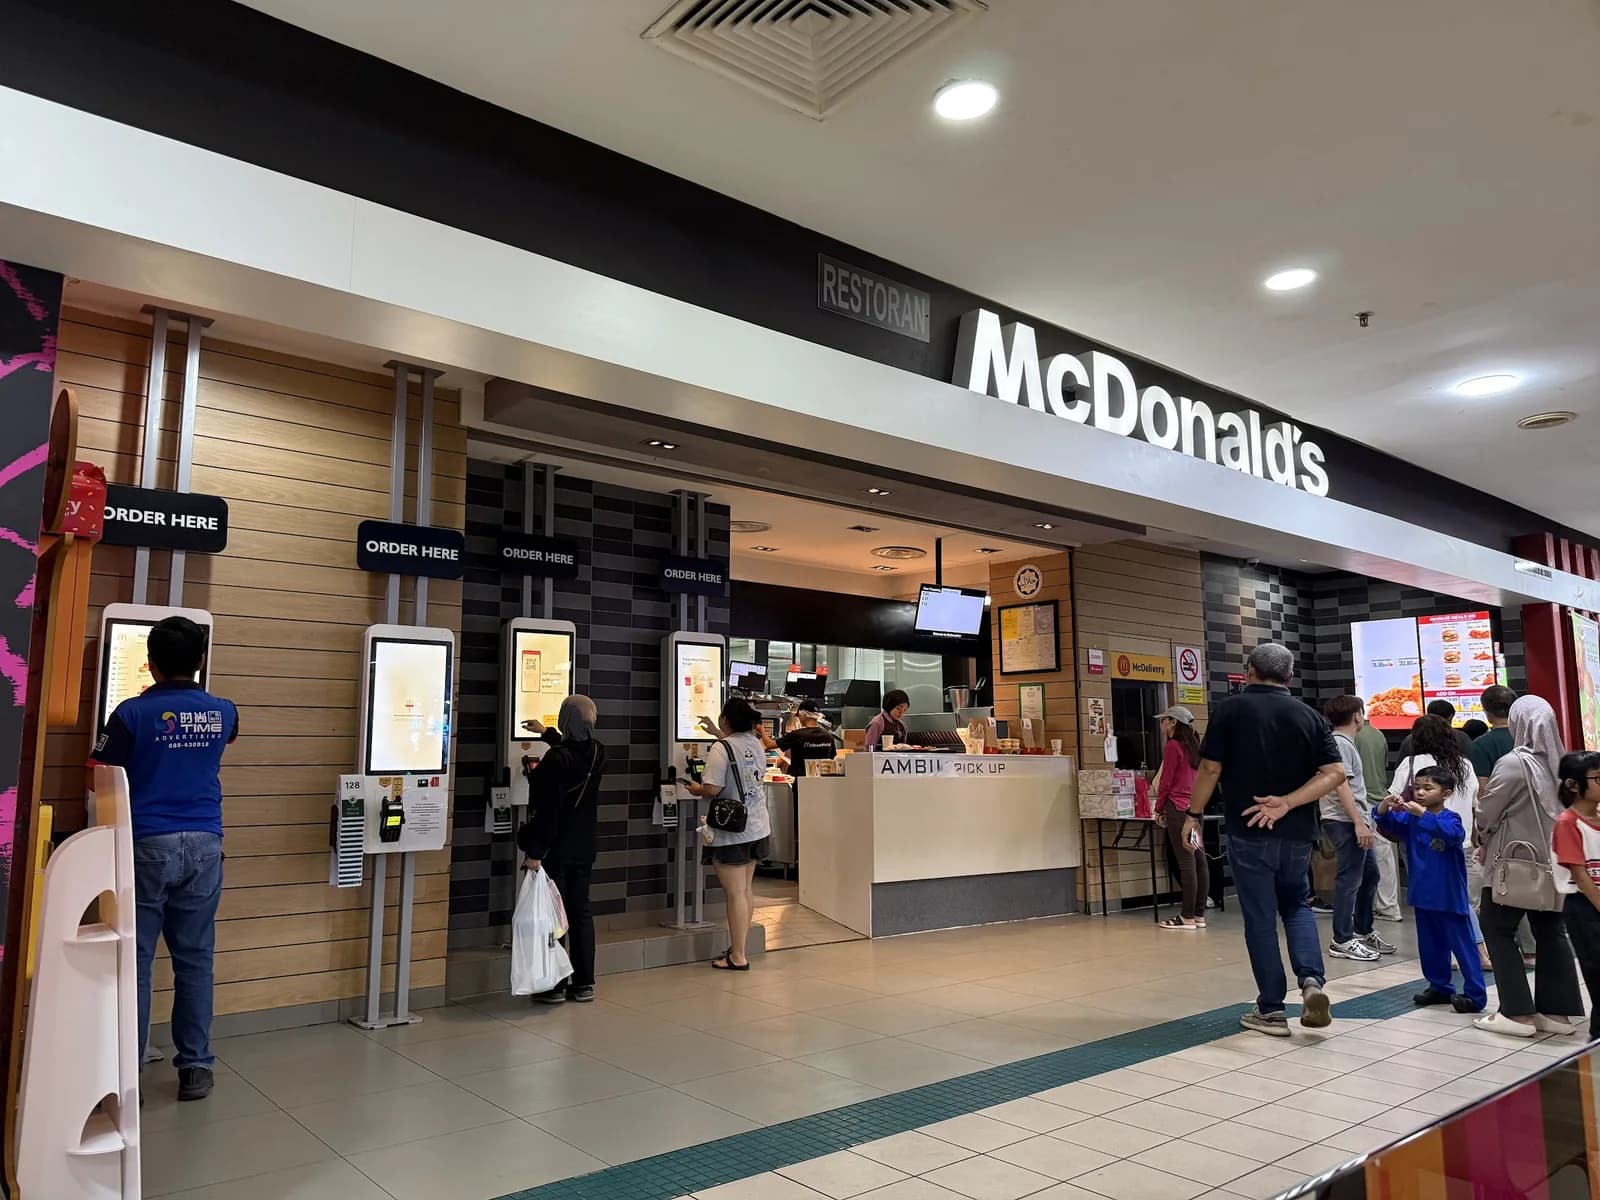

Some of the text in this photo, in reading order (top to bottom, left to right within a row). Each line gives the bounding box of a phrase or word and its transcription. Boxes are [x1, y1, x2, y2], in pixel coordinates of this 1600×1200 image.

[823, 263, 926, 334] RESTORAN
[968, 308, 1329, 497] McDonald's
[103, 506, 218, 531] ORDER HERE
[366, 540, 459, 561] ORDER HERE
[502, 547, 574, 565] ORDER HERE
[664, 568, 722, 584] ORDER HERE
[1132, 663, 1165, 676] McDelivery
[180, 723, 223, 733] TIME
[988, 763, 1006, 774] UP
[345, 781, 360, 789] 128
[495, 792, 507, 800] 127
